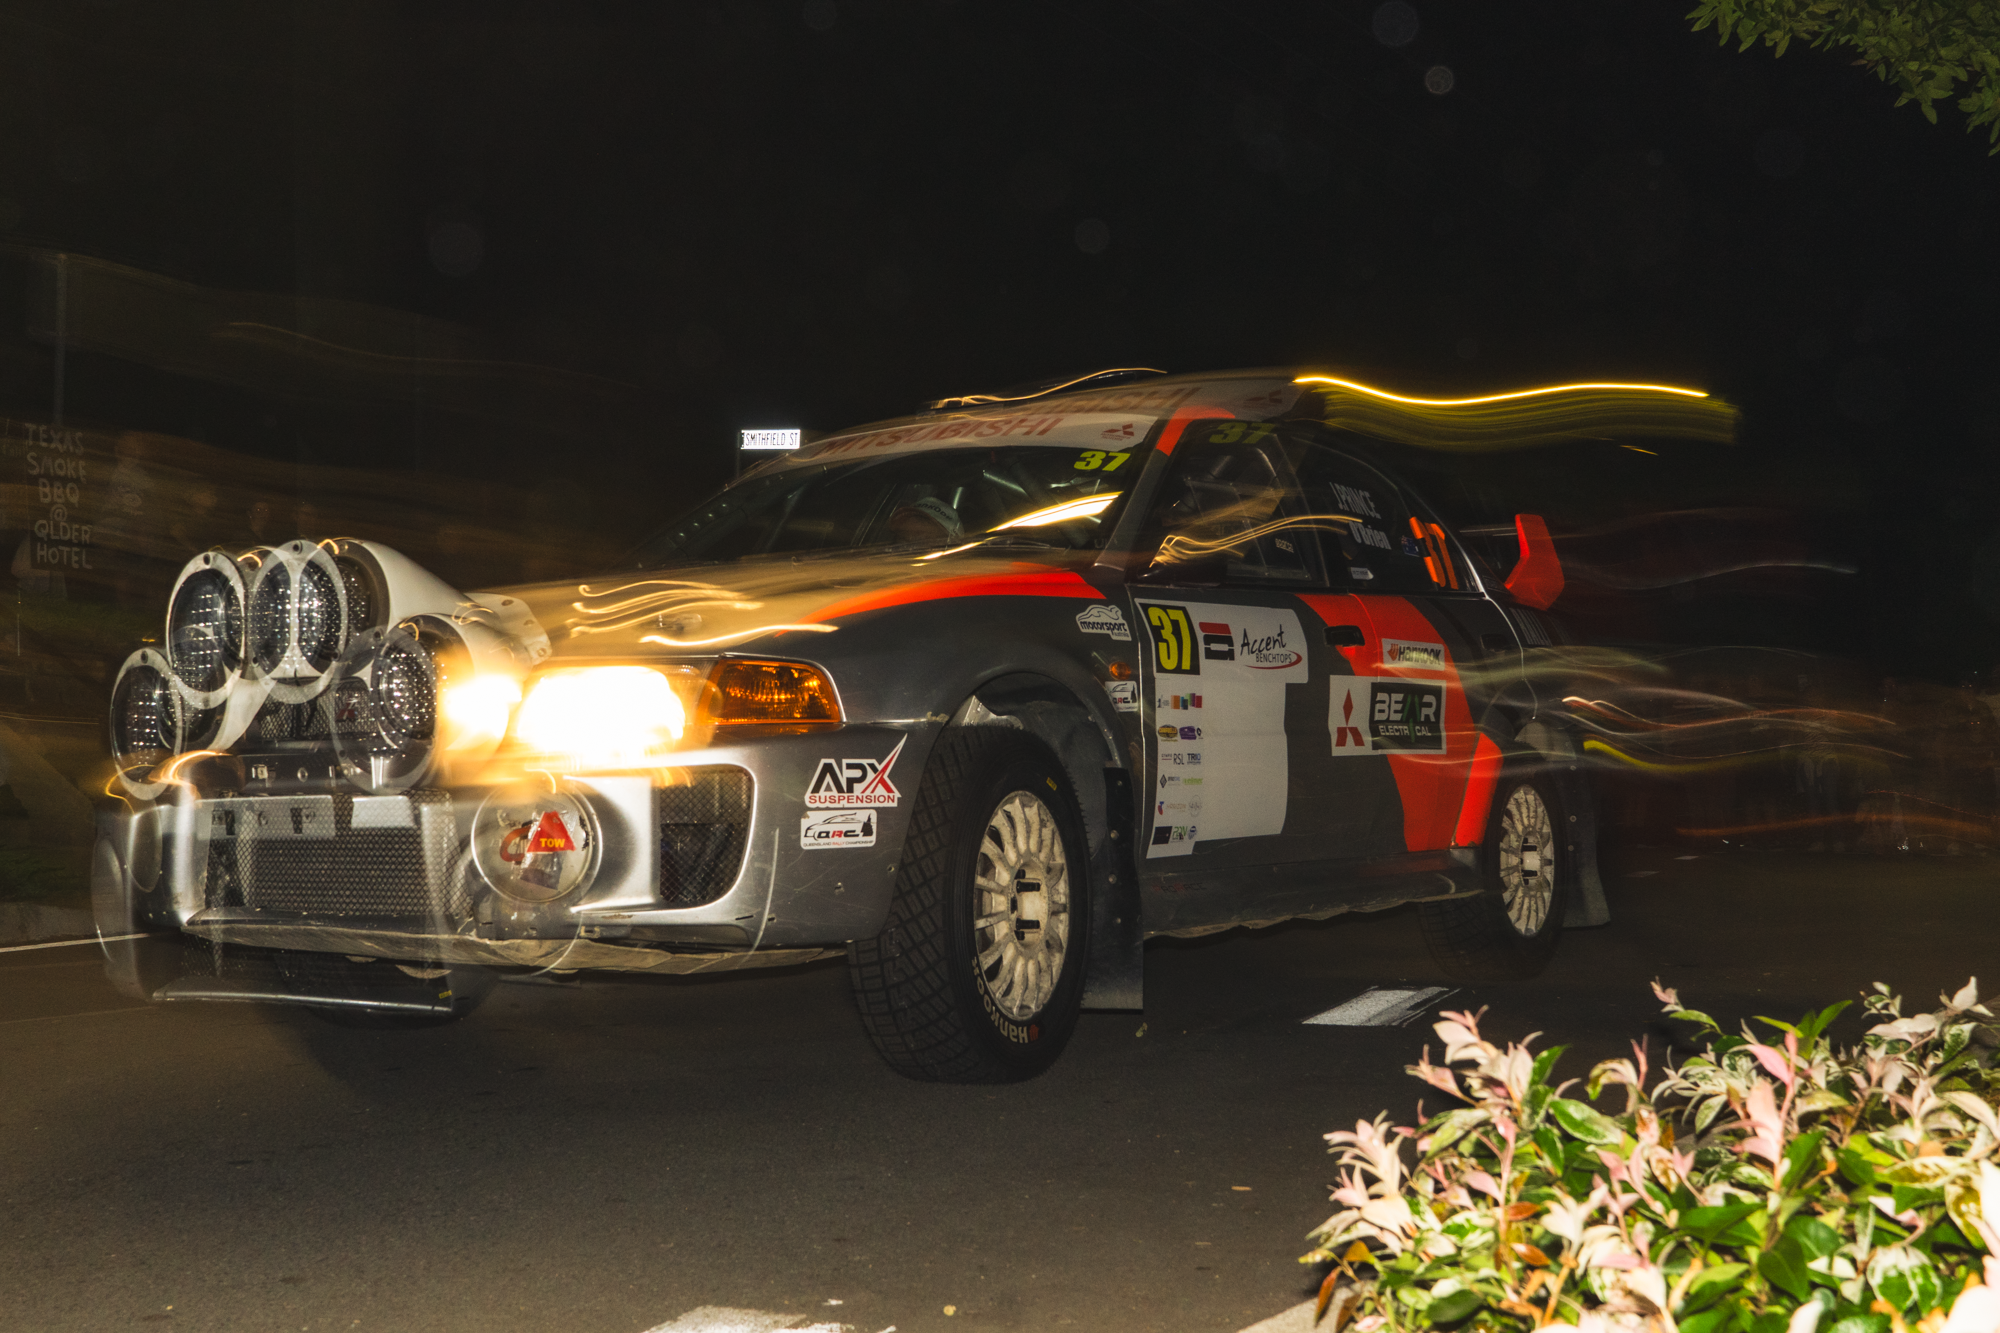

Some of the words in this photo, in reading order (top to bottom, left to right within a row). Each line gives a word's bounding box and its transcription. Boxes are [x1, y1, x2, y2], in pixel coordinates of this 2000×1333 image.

[25, 423, 84, 455] TEXAS
[745, 432, 786, 446] SMITHFIELD
[789, 432, 798, 446] ST
[810, 417, 1065, 459] MITSUBISHI
[1209, 421, 1276, 444] 37
[26, 452, 87, 484] SMOKE
[1073, 450, 1131, 472] 37
[38, 478, 80, 508] BBQ
[50, 504, 68, 522] @
[36, 542, 93, 569] HOTEL
[1409, 516, 1459, 590] 37
[1080, 621, 1127, 635] motorsport
[1147, 606, 1192, 671] 37
[1240, 624, 1287, 656] Accent
[1255, 652, 1293, 664] BENCHTOPS
[1373, 692, 1437, 722] BEAR
[1378, 722, 1432, 740] ELECTRICAL
[810, 748, 900, 794] APX
[1173, 753, 1185, 765] RSL
[808, 795, 895, 804] SUSPENSION
[539, 838, 565, 848] TOW
